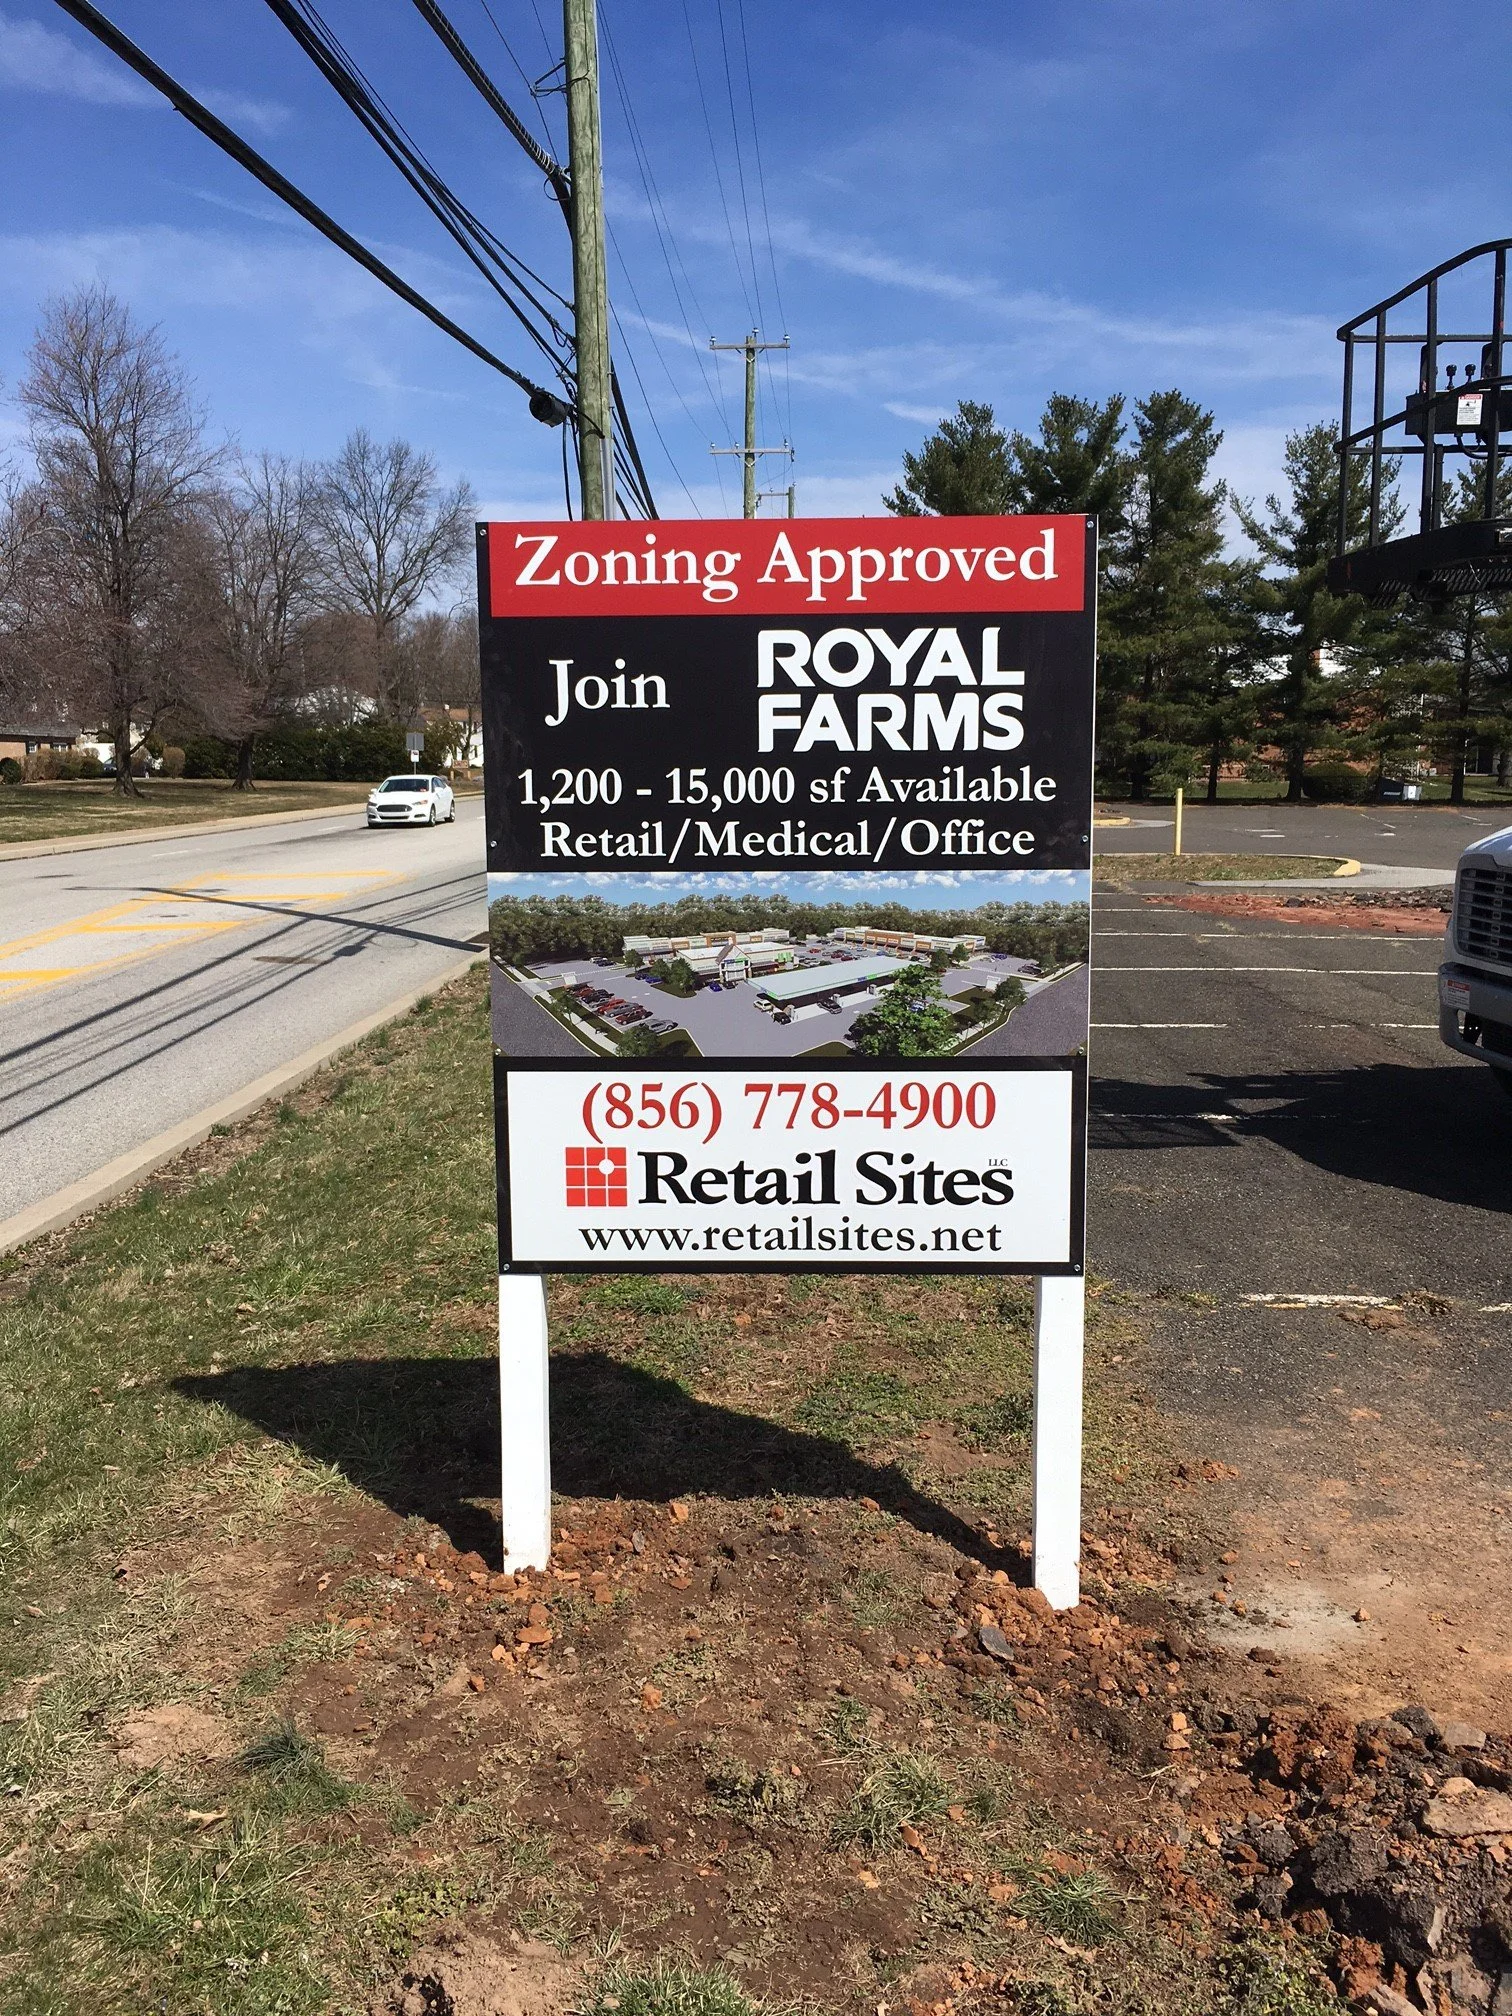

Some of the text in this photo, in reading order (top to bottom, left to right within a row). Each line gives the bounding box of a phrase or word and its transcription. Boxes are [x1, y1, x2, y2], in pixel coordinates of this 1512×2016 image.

[515, 528, 1058, 602] Zoning Approved
[757, 627, 1024, 687] ROYAL
[545, 659, 670, 726] Join
[758, 693, 1024, 752] FARMS
[518, 769, 622, 813] 1,200
[666, 767, 794, 812] 15,000
[810, 767, 851, 803] sf
[858, 766, 1057, 802] Available
[540, 817, 1034, 863] Retail/Medical/Office
[582, 1082, 996, 1144] (856) 778-4900
[638, 1149, 1014, 1205] Retail Sites LLC
[579, 1216, 1002, 1252] www.retailsites.net
